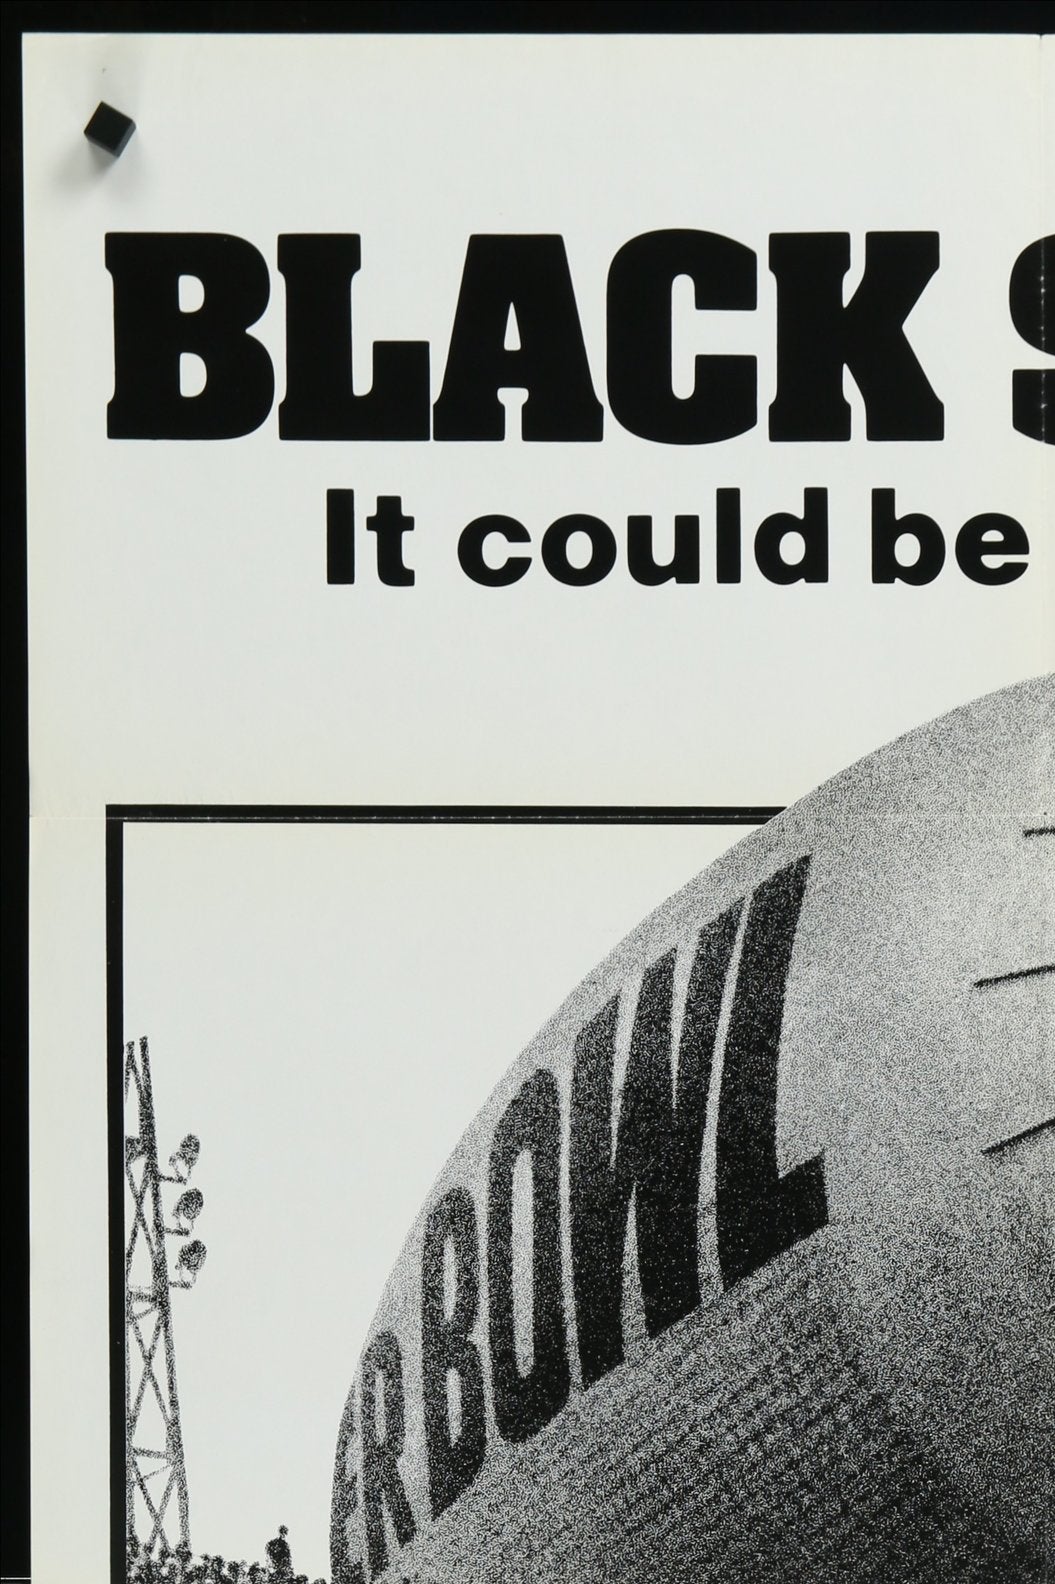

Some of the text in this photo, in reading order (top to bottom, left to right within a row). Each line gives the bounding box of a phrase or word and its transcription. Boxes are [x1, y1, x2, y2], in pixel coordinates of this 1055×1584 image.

[105, 229, 944, 445] BLACK
[327, 489, 414, 586] It
[458, 487, 828, 587] could
[872, 488, 1029, 586] be
[421, 854, 829, 1526] BOWL
